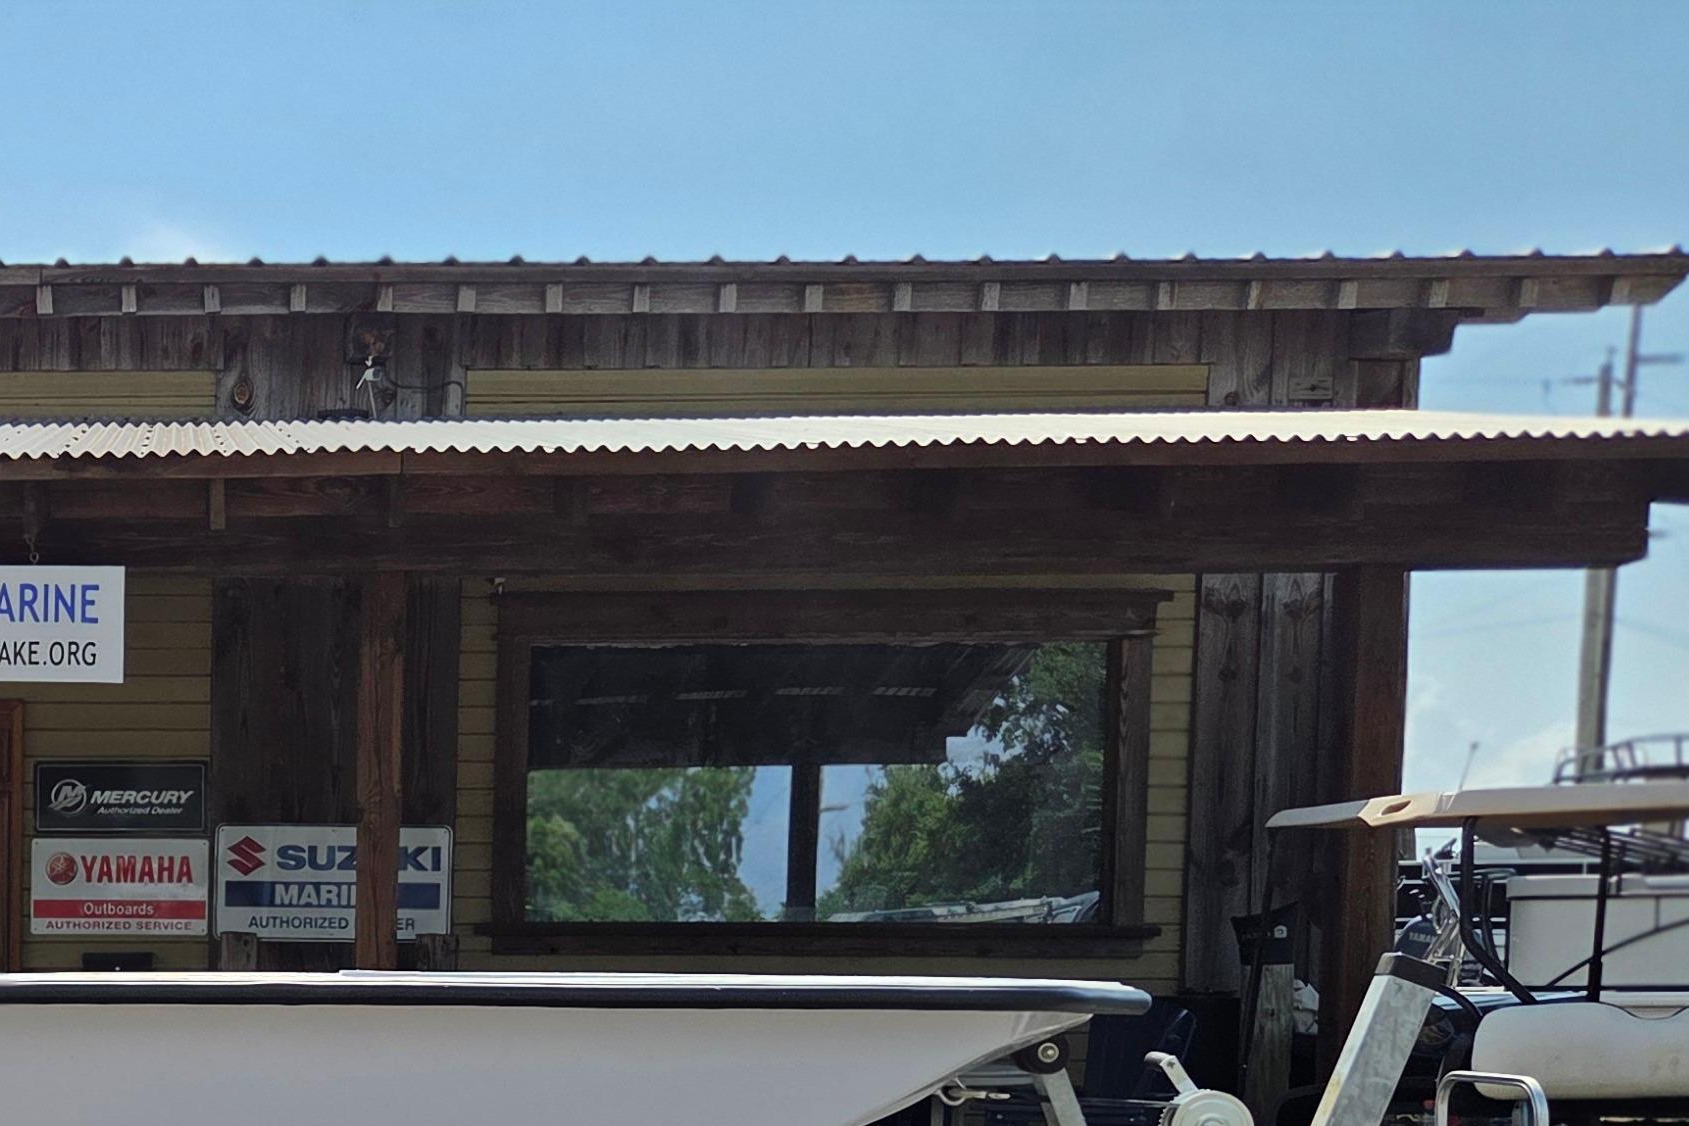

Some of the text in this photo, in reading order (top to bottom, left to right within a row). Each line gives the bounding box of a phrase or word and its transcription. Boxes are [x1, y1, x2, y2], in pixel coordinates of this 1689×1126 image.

[90, 790, 194, 805] MERCURY
[97, 806, 183, 815] Authorized Dealer
[276, 844, 441, 872] SUZKI
[80, 854, 193, 885] YAMAHA
[275, 884, 357, 907] MARI
[83, 902, 154, 917] Outboards
[46, 920, 192, 931] AUTHORIZED SERVICE
[248, 915, 349, 930] AUTHORIZED
